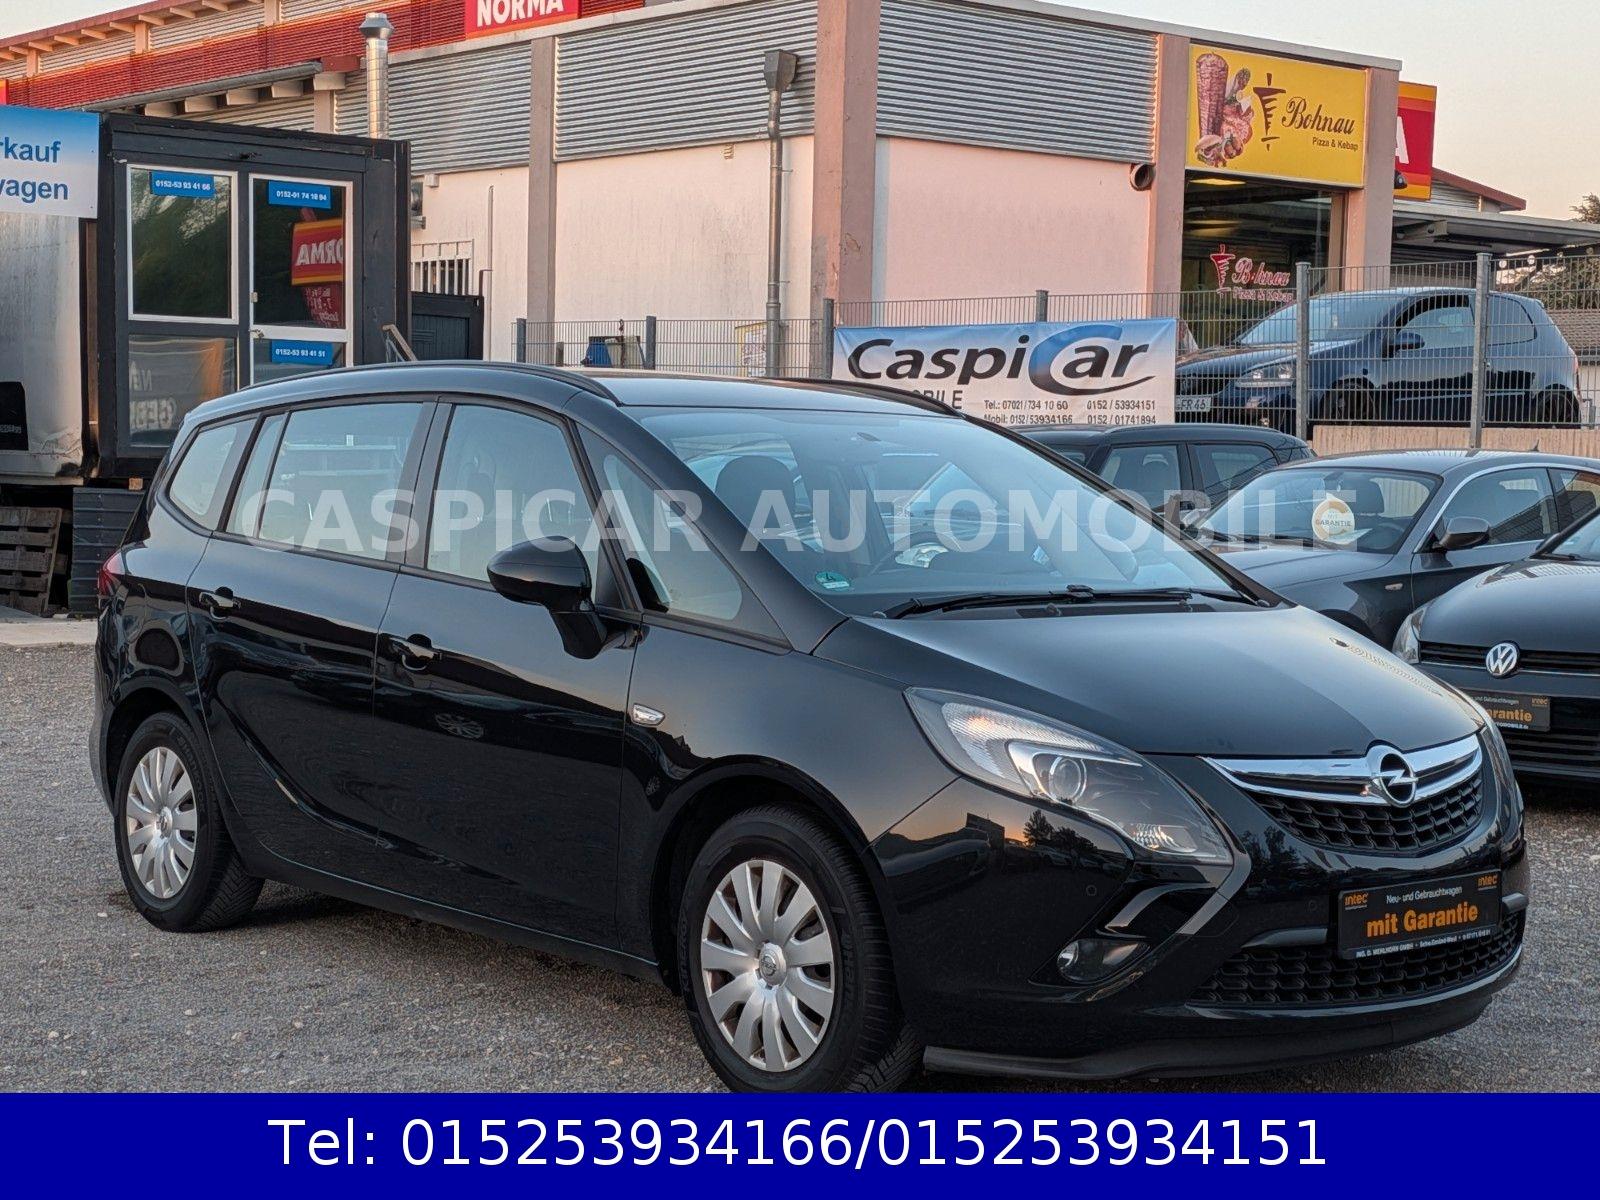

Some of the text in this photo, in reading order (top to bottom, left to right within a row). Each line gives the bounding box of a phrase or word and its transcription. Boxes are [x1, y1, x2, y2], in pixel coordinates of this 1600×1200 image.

[1281, 96, 1355, 135] Bohnau
[1312, 137, 1359, 152] Pizza & Kebap
[1231, 257, 1291, 286] Bhnau
[847, 324, 1156, 396] CaspiCar
[984, 400, 1001, 410] Tel.:
[1087, 400, 1108, 410] 0152
[1087, 414, 1108, 425] 0152
[1486, 708, 1533, 722] arantie
[1366, 901, 1479, 938] mit Garantie
